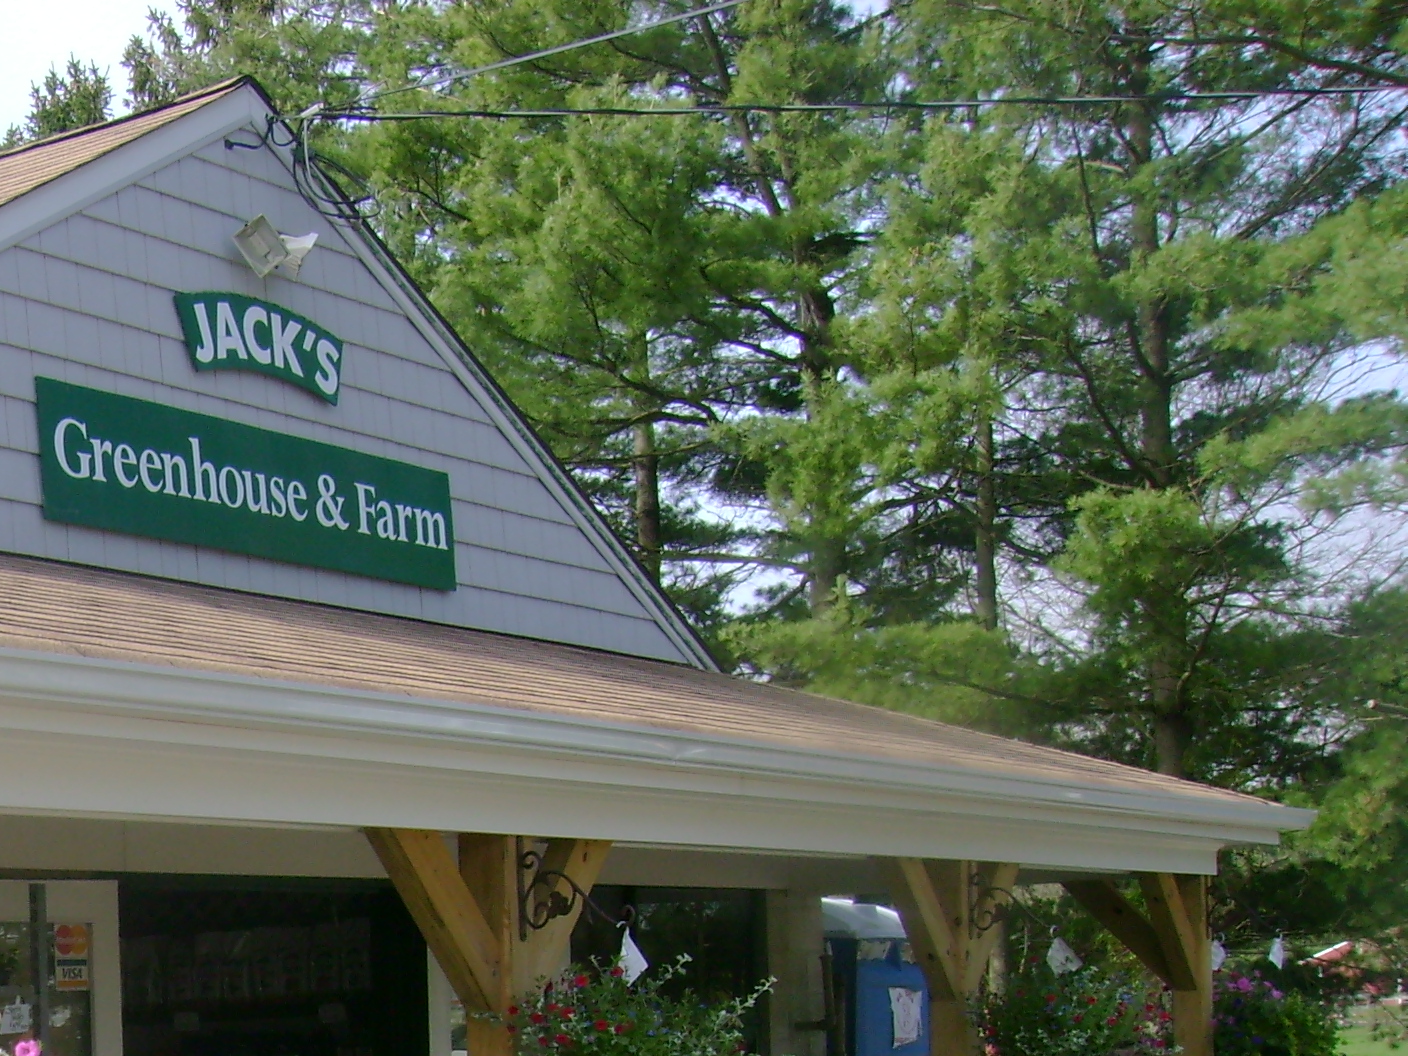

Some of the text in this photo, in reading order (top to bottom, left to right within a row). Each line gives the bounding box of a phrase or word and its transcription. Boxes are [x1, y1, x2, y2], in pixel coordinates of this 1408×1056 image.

[194, 301, 340, 396] JACK'S
[53, 416, 449, 551] Greenhouse & Farm
[61, 967, 83, 979] VISA
